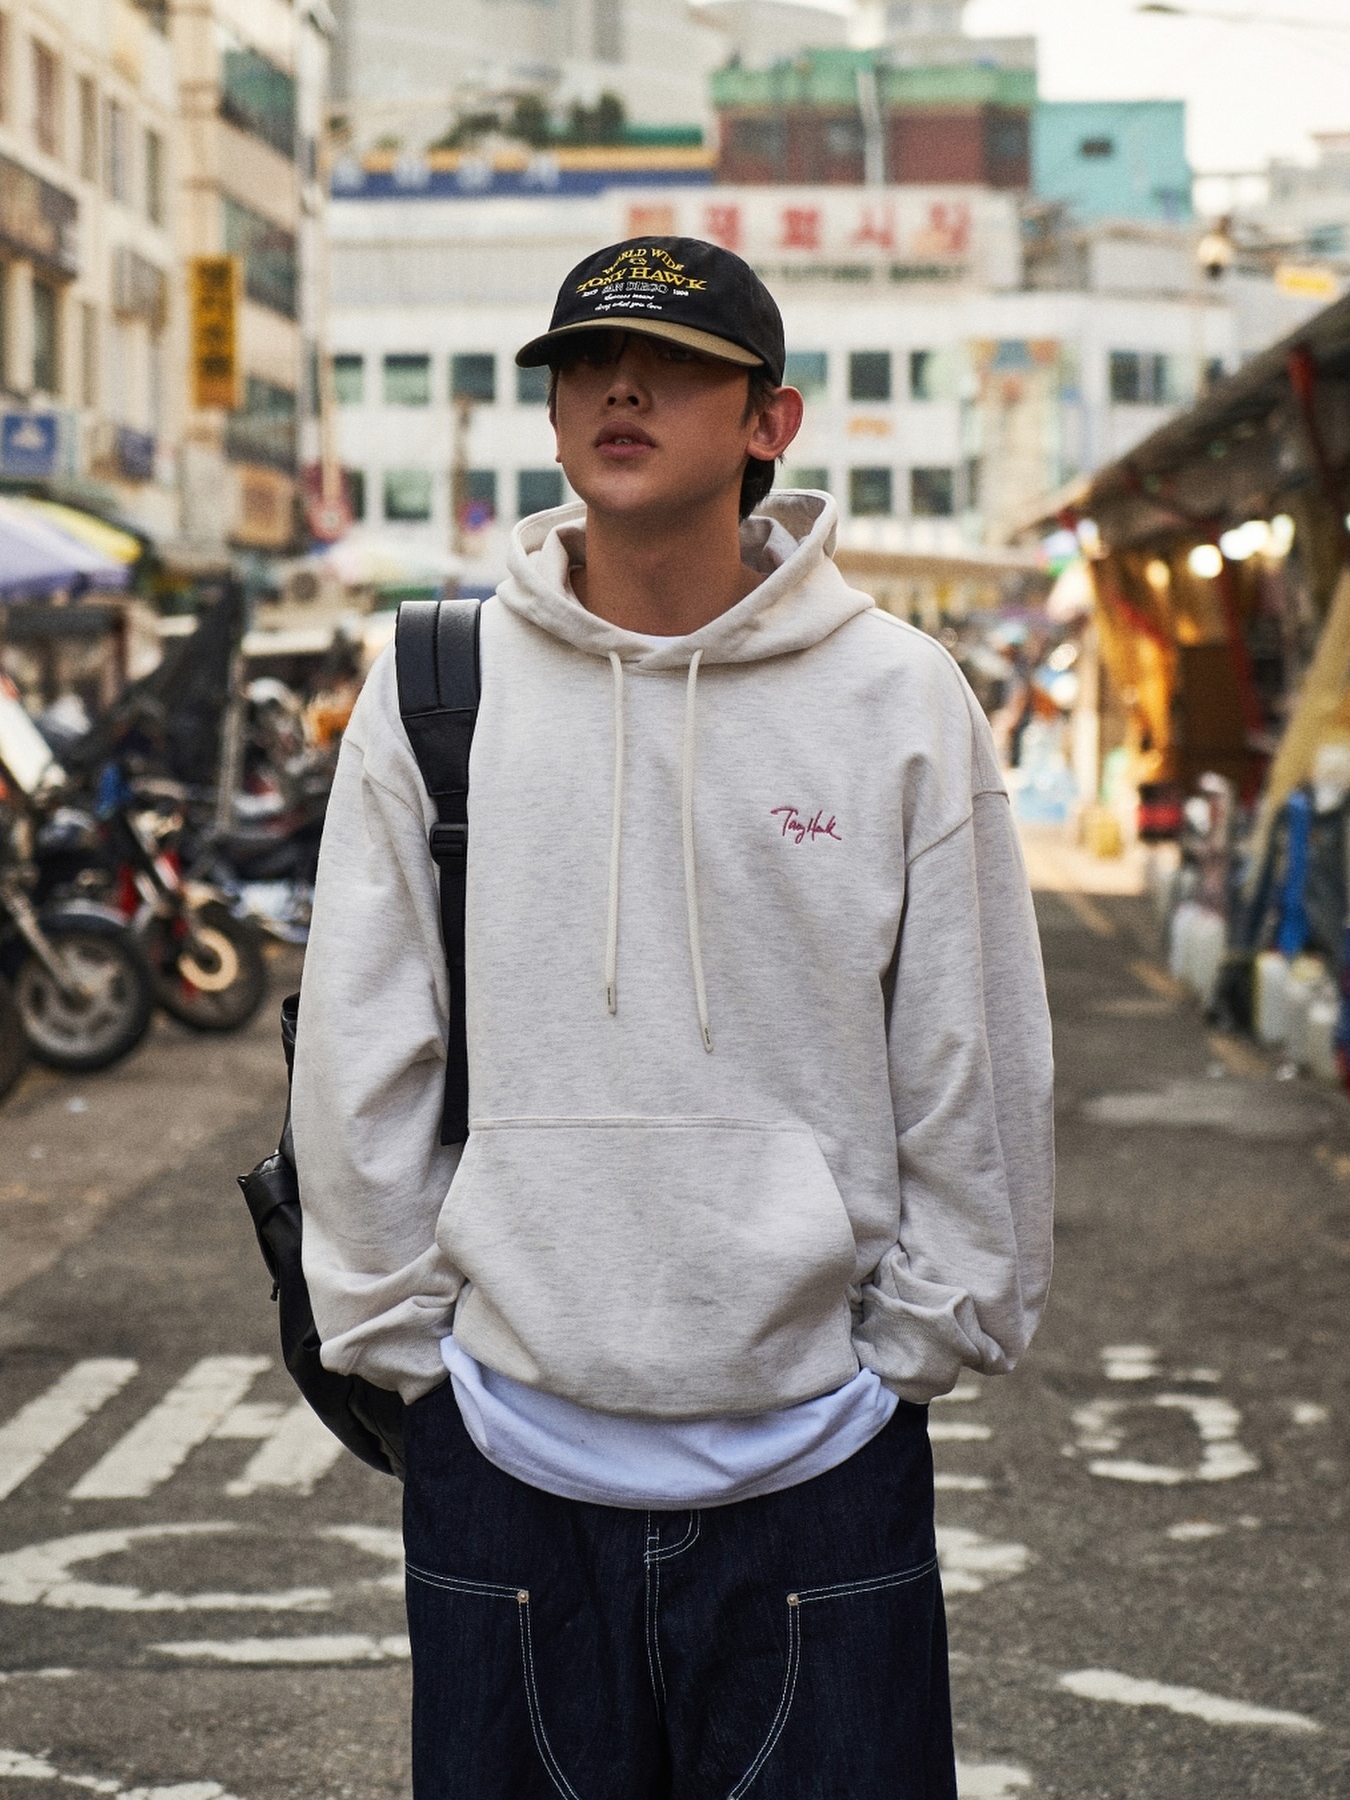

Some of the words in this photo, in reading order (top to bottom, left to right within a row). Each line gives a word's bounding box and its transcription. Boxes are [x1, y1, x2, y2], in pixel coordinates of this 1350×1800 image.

[602, 248, 647, 275] WORLD
[651, 247, 685, 272] WIDE
[575, 267, 628, 294] TONY
[628, 267, 708, 290] HAWK
[601, 281, 625, 295] SAN
[625, 280, 669, 294] DIEGO
[770, 806, 806, 845] Tony
[806, 809, 842, 842] Hawk
